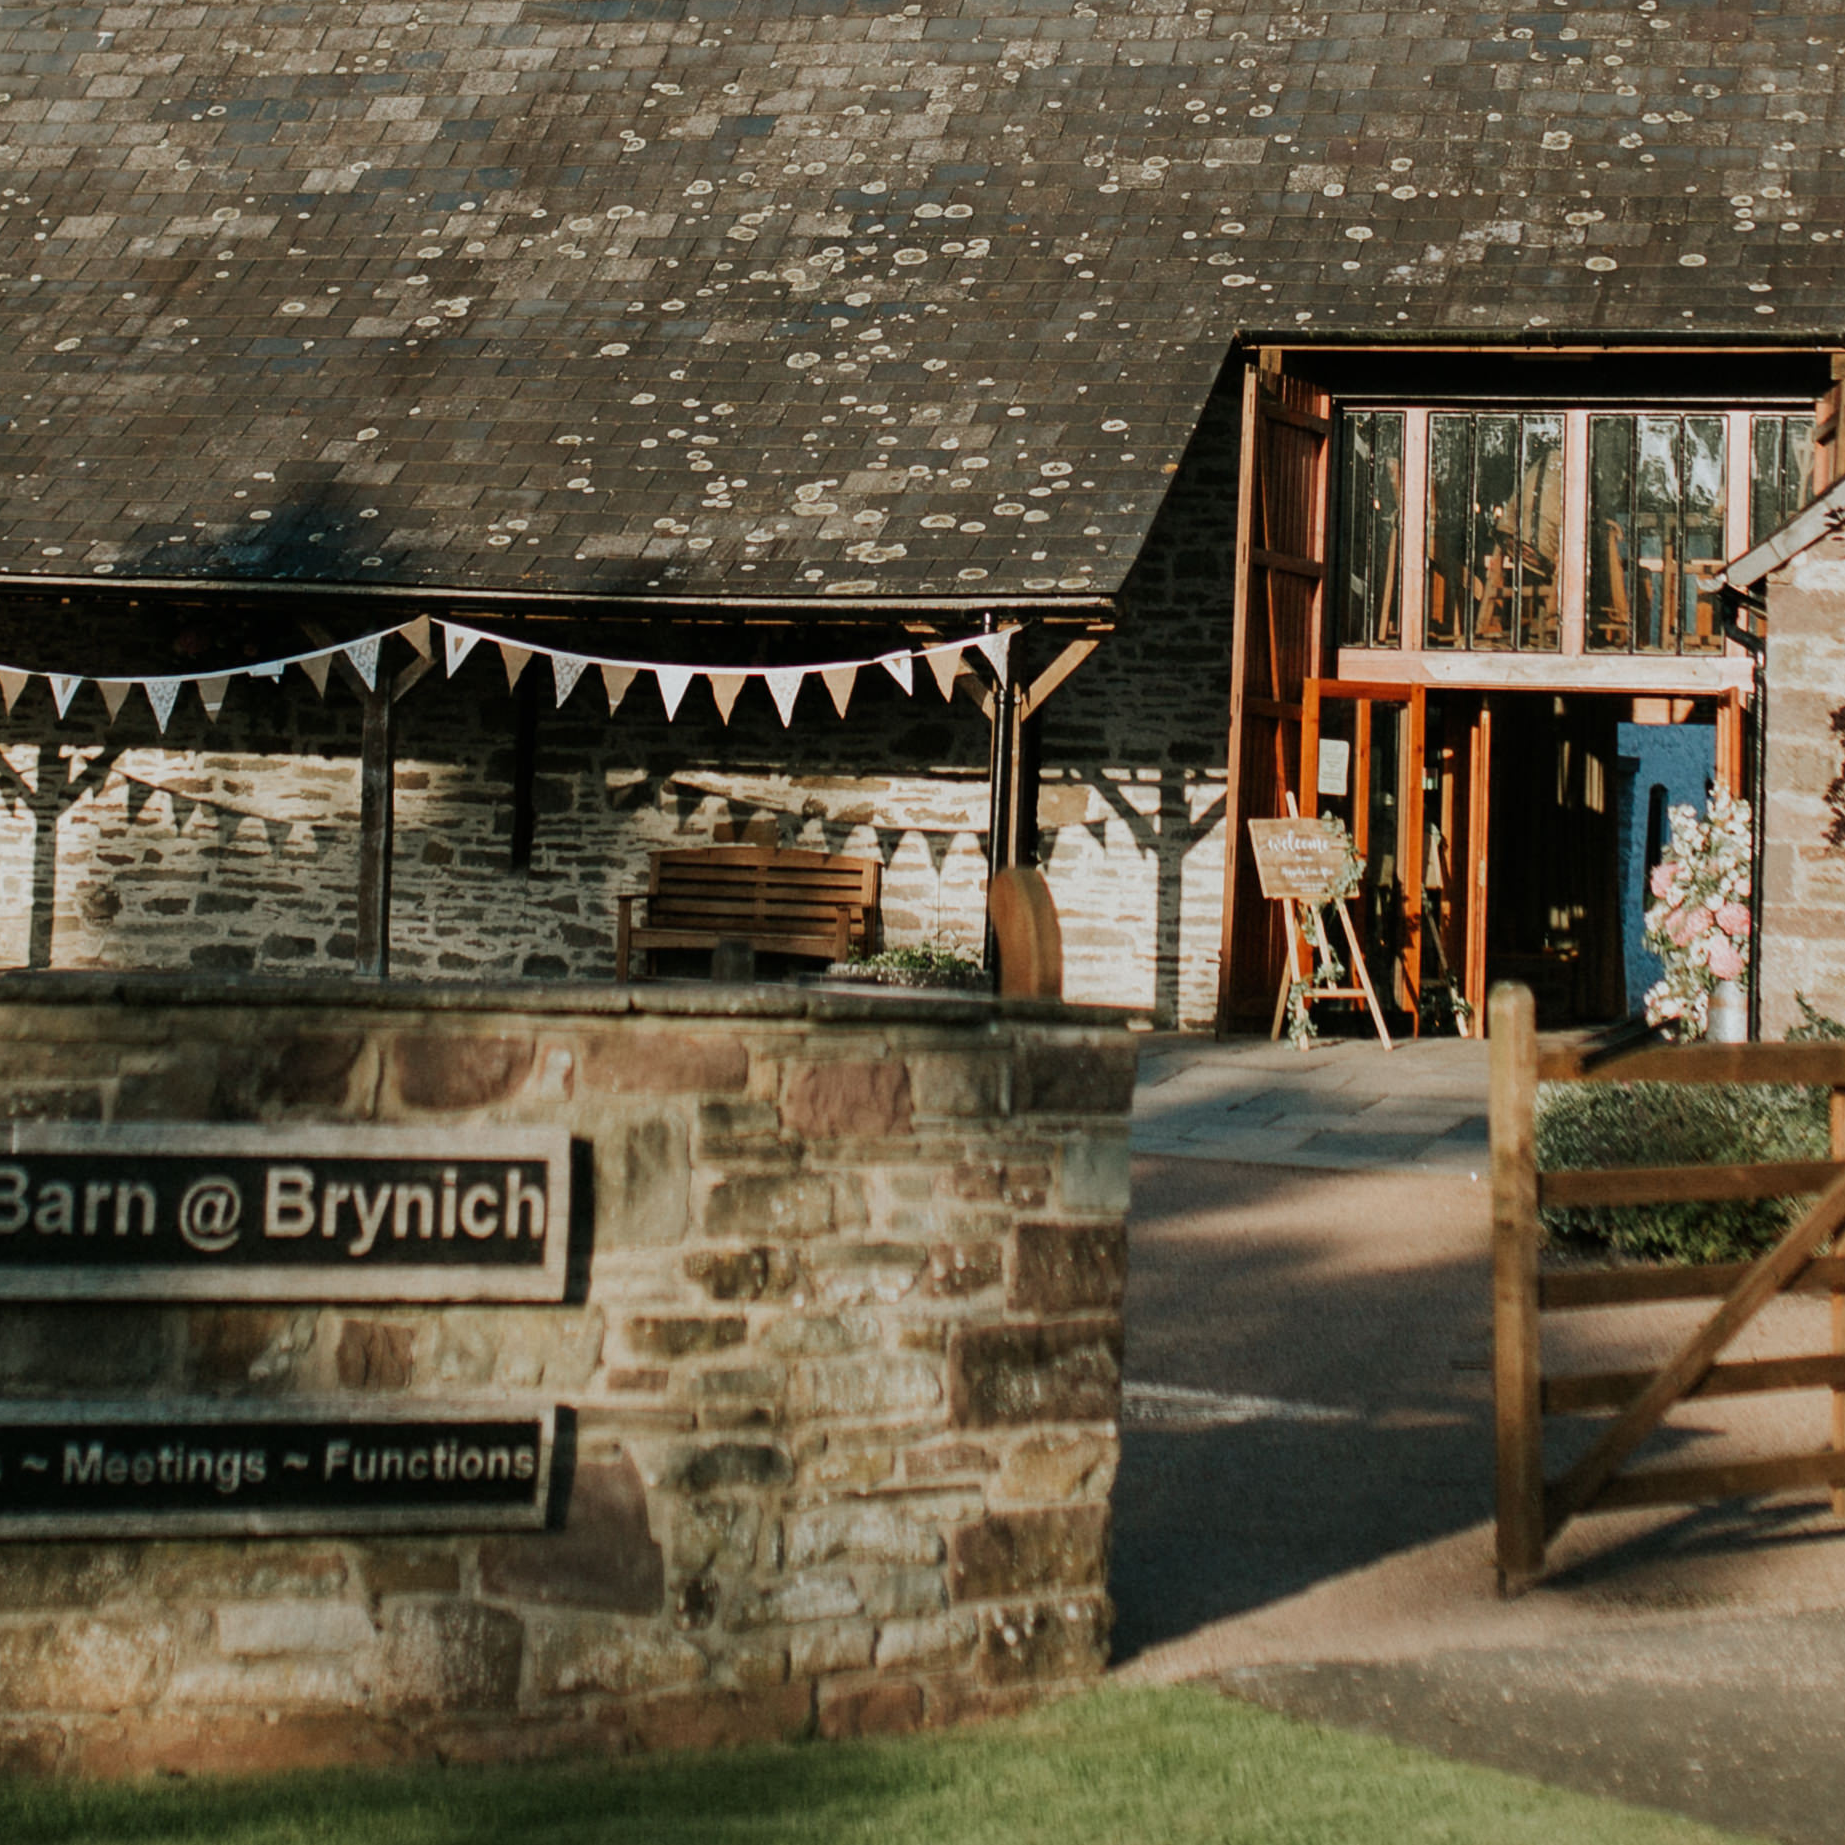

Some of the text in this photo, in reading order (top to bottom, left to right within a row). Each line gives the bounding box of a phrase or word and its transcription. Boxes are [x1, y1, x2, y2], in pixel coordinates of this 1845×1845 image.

[178, 1175, 243, 1253] @
[264, 1165, 546, 1257] Brynich
[62, 1440, 267, 1494] Meetings
[324, 1439, 536, 1483] Functions
